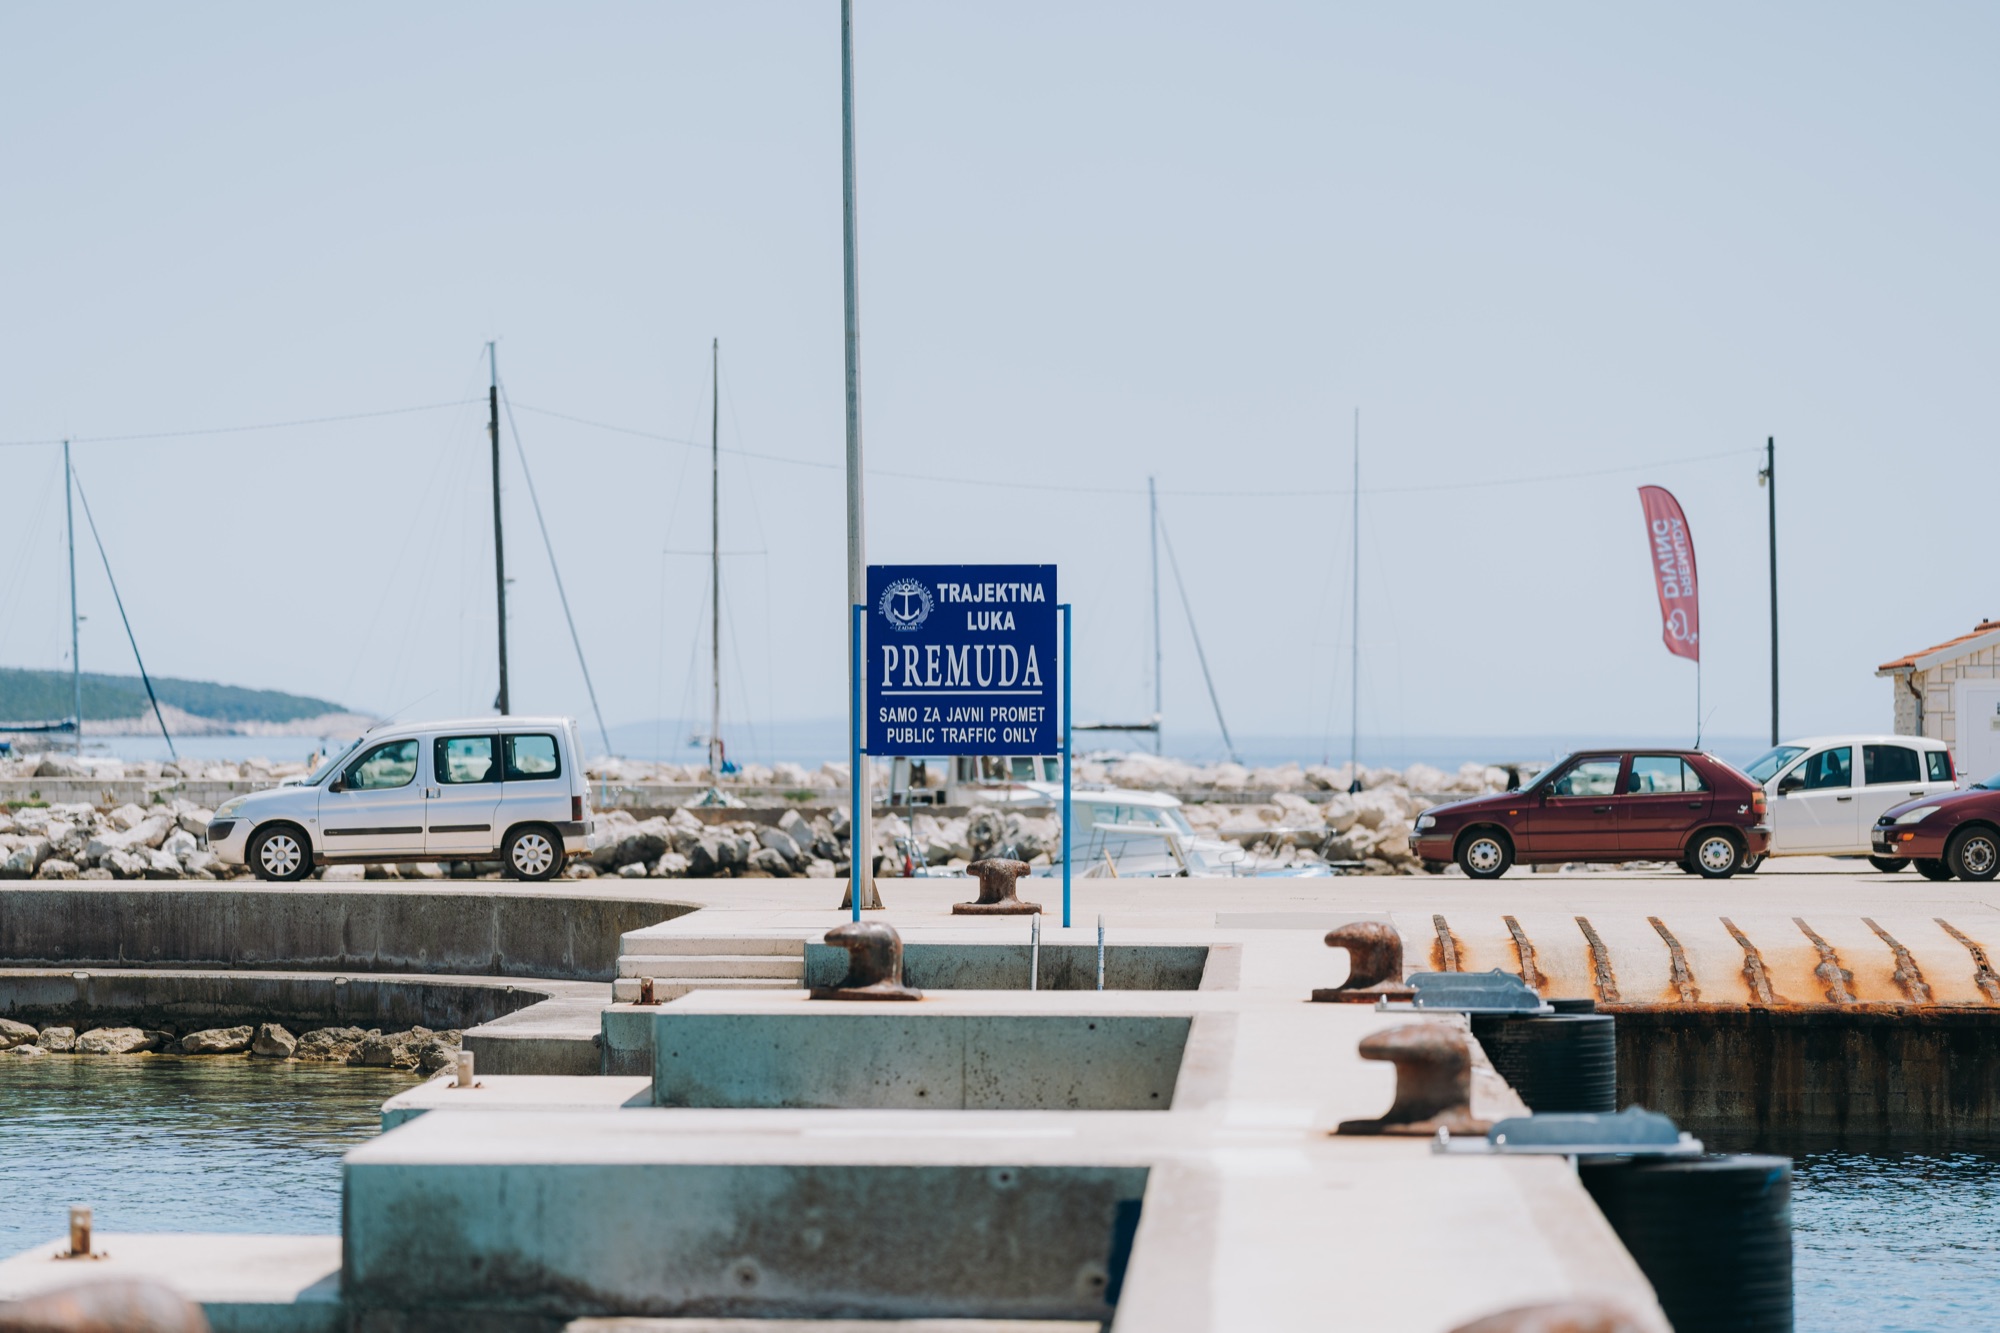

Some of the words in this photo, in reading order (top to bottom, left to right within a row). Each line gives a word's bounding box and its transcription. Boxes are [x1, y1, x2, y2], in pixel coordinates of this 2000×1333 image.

[937, 583, 1046, 603] TRAJEKTNA
[967, 611, 1016, 631] LUKA
[881, 644, 1043, 687] PREMUDA
[879, 707, 918, 722] SAMO
[923, 707, 941, 722] ZA
[946, 707, 984, 722] JAVNI
[990, 706, 1046, 722] PROMET
[887, 727, 935, 743] PUBLIC
[941, 727, 997, 743] TRAFFIC
[1003, 727, 1038, 743] ONLY
